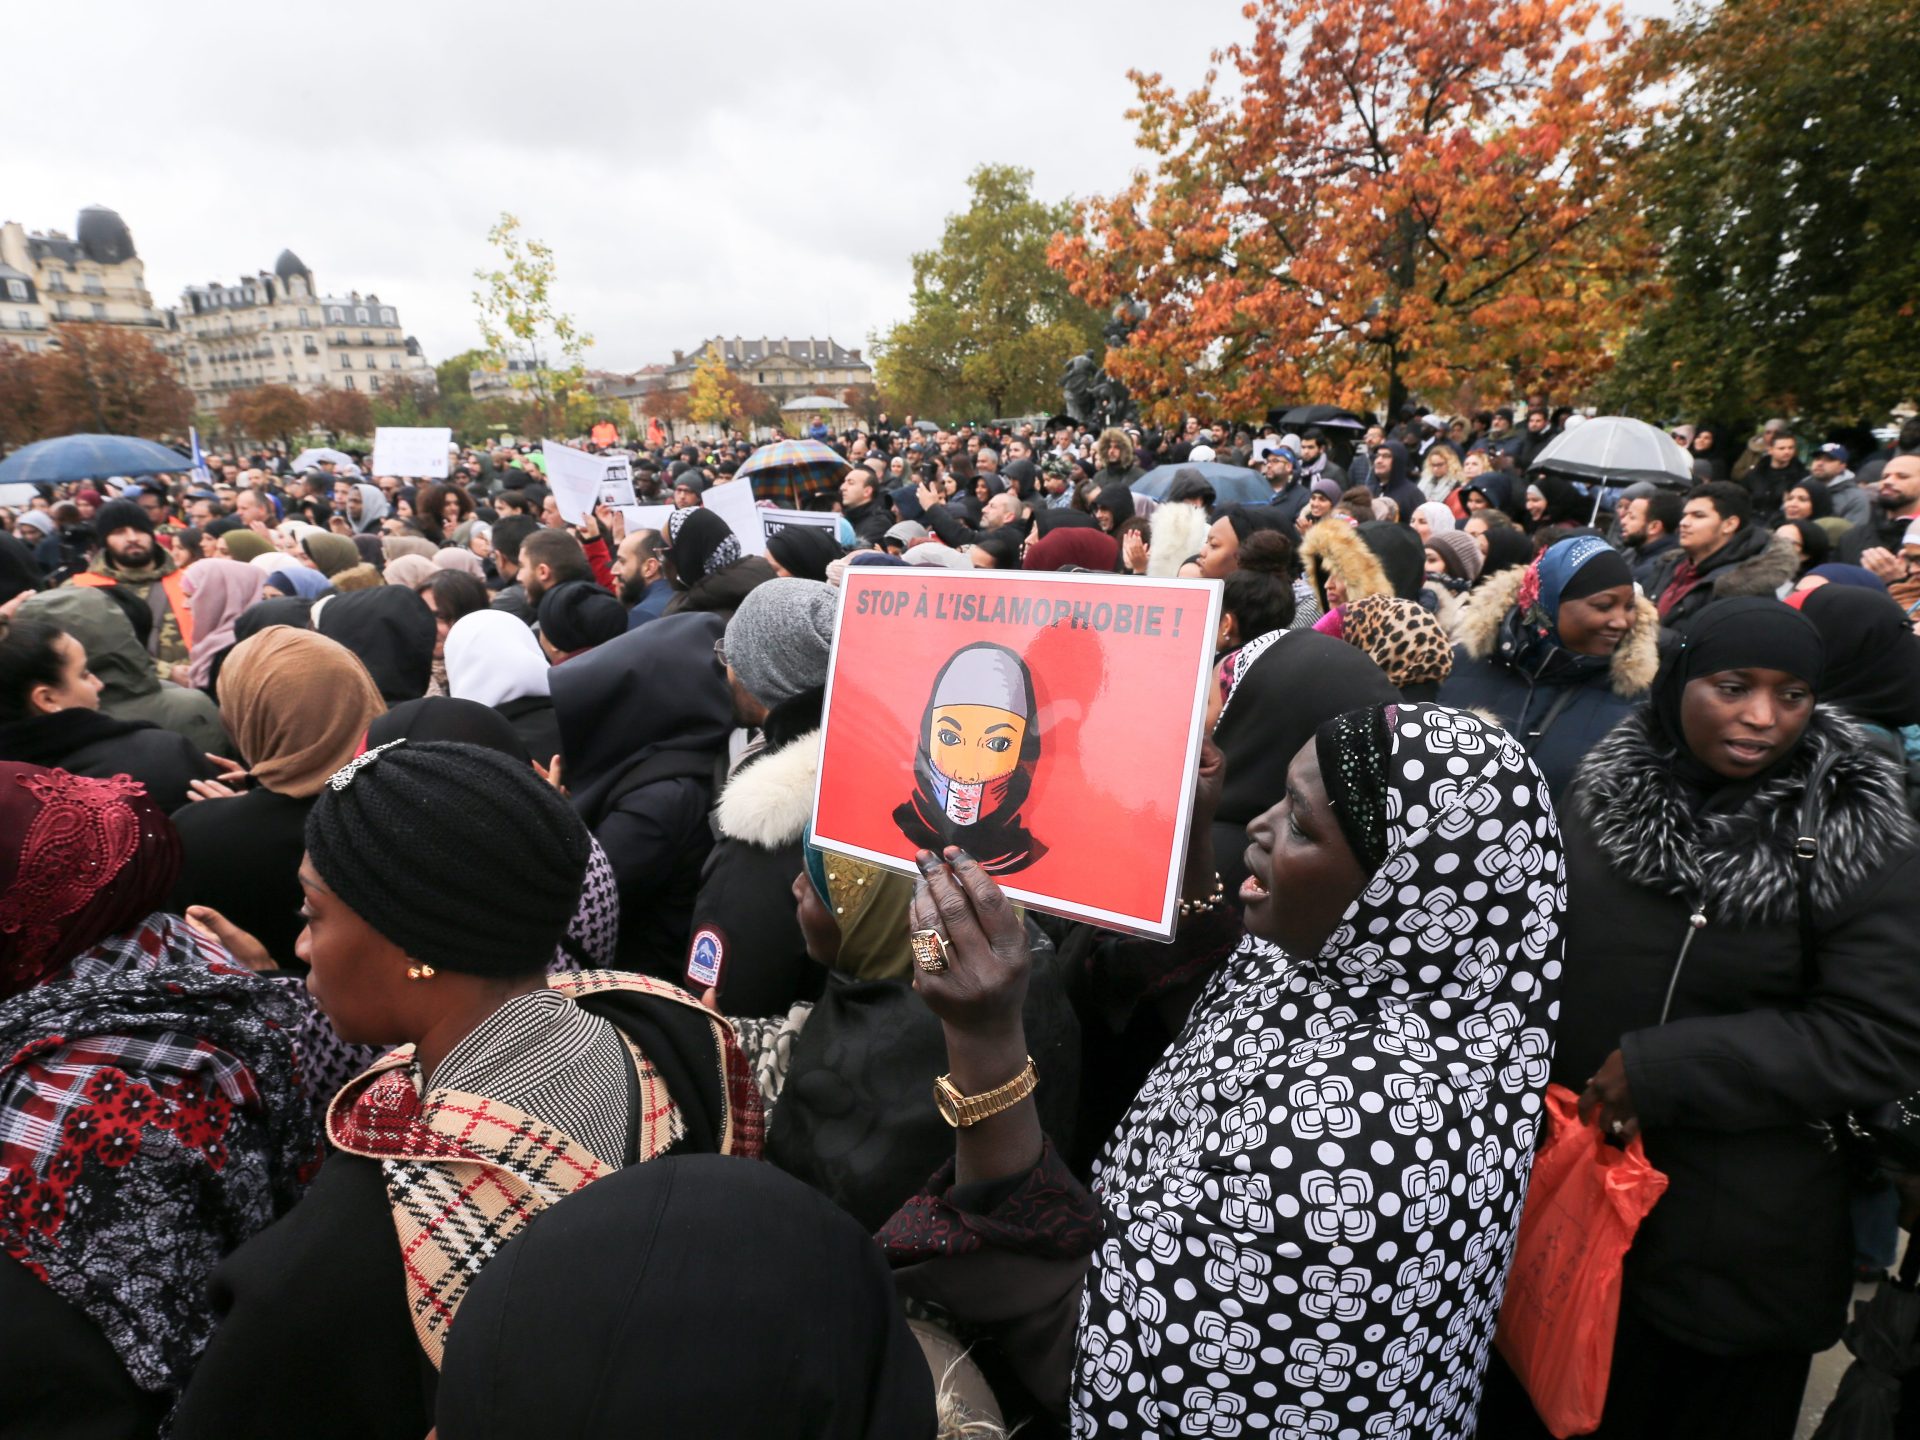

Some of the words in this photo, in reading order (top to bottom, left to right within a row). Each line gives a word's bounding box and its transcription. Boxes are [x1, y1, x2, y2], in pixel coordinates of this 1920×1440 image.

[856, 589, 910, 616] STOP
[913, 585, 929, 618] À
[935, 593, 1165, 637] L'ISLAMOPHOBIE
[1172, 608, 1183, 637] !
